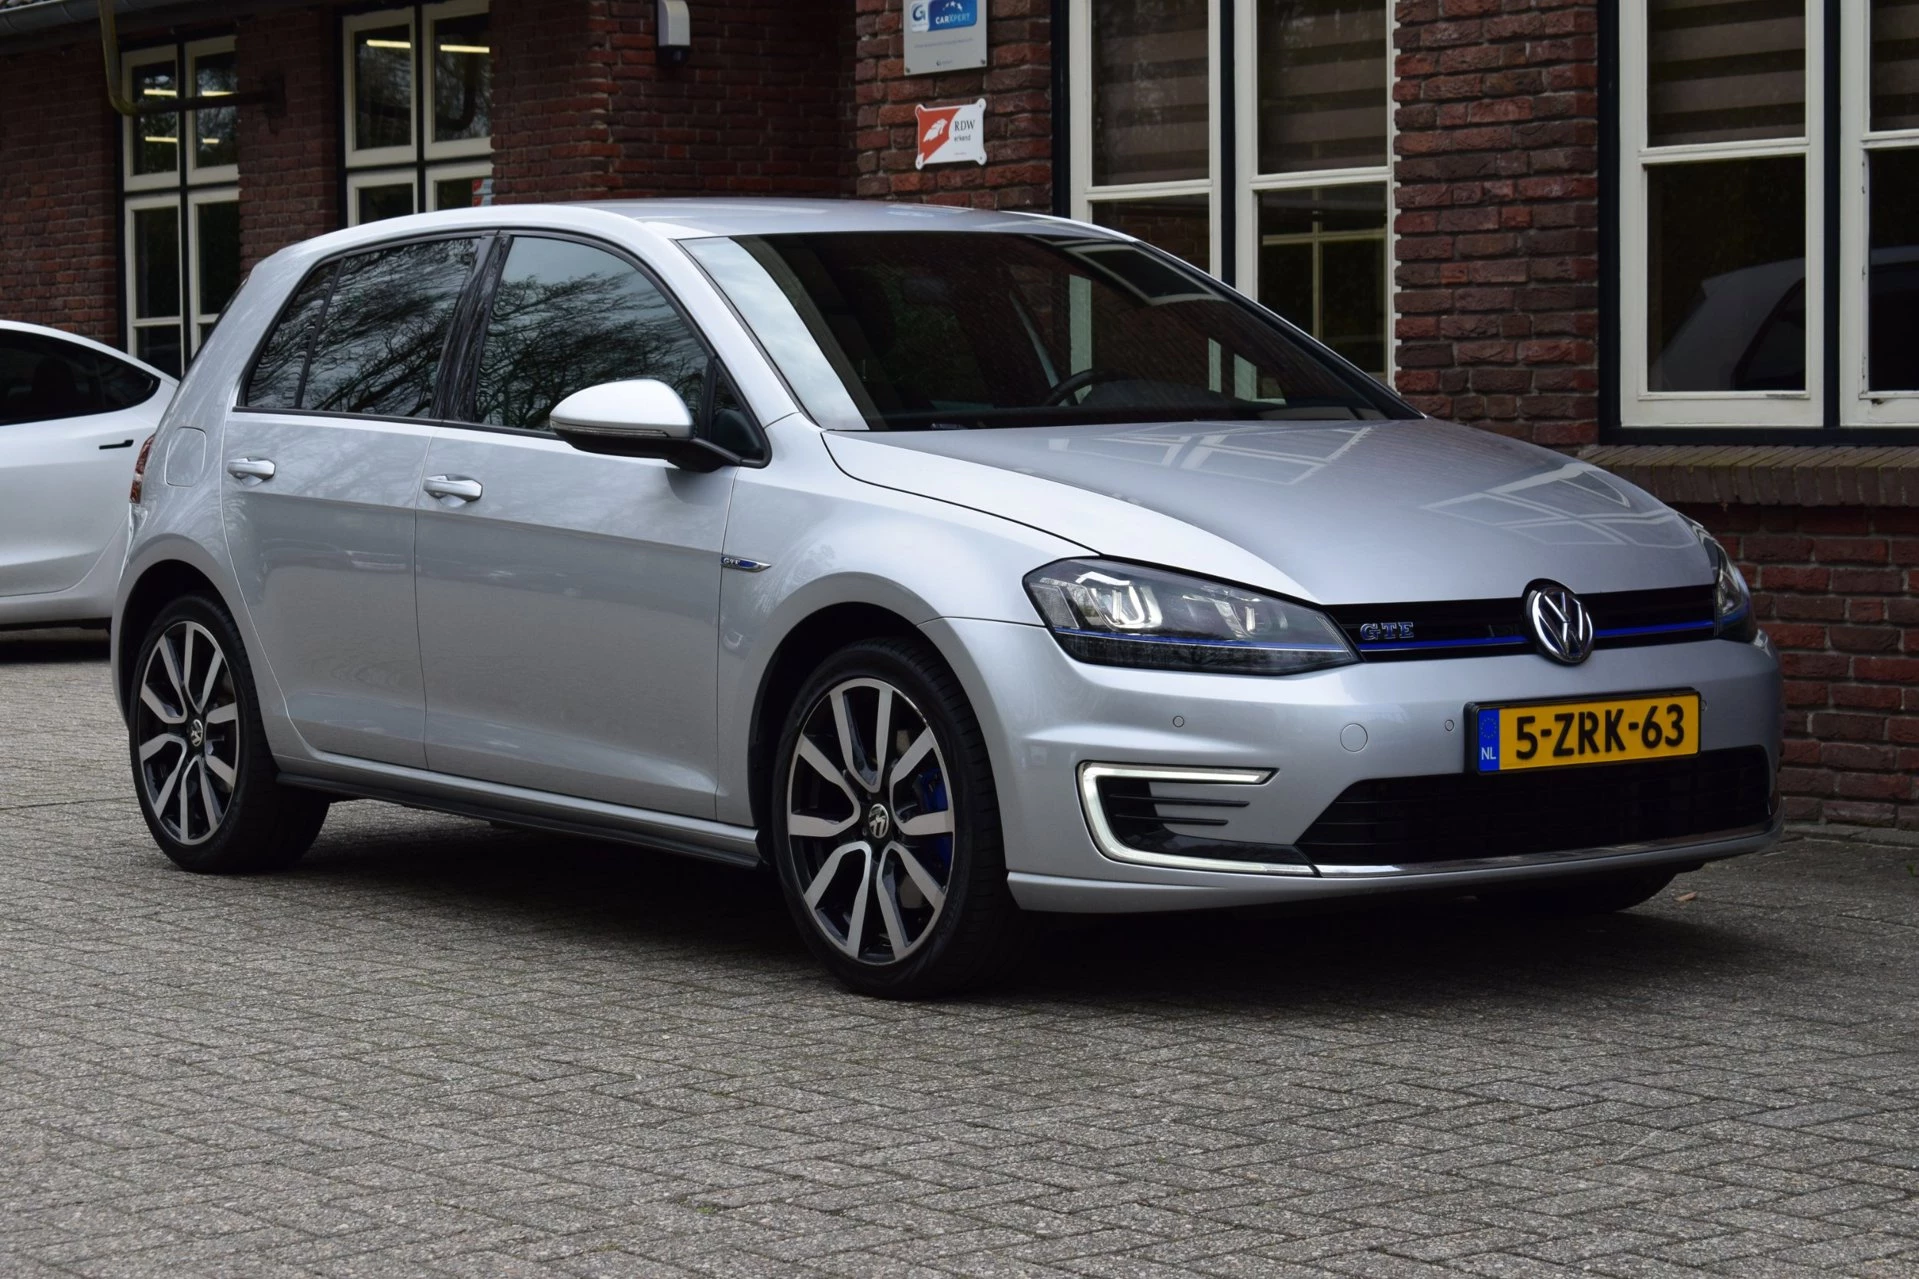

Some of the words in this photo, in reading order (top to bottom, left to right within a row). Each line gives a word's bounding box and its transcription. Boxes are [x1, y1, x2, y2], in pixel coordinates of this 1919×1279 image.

[954, 120, 976, 131] RDW
[1360, 621, 1415, 641] GTE
[1515, 703, 1685, 760] 5-ZRK-63
[1481, 747, 1497, 760] NL
